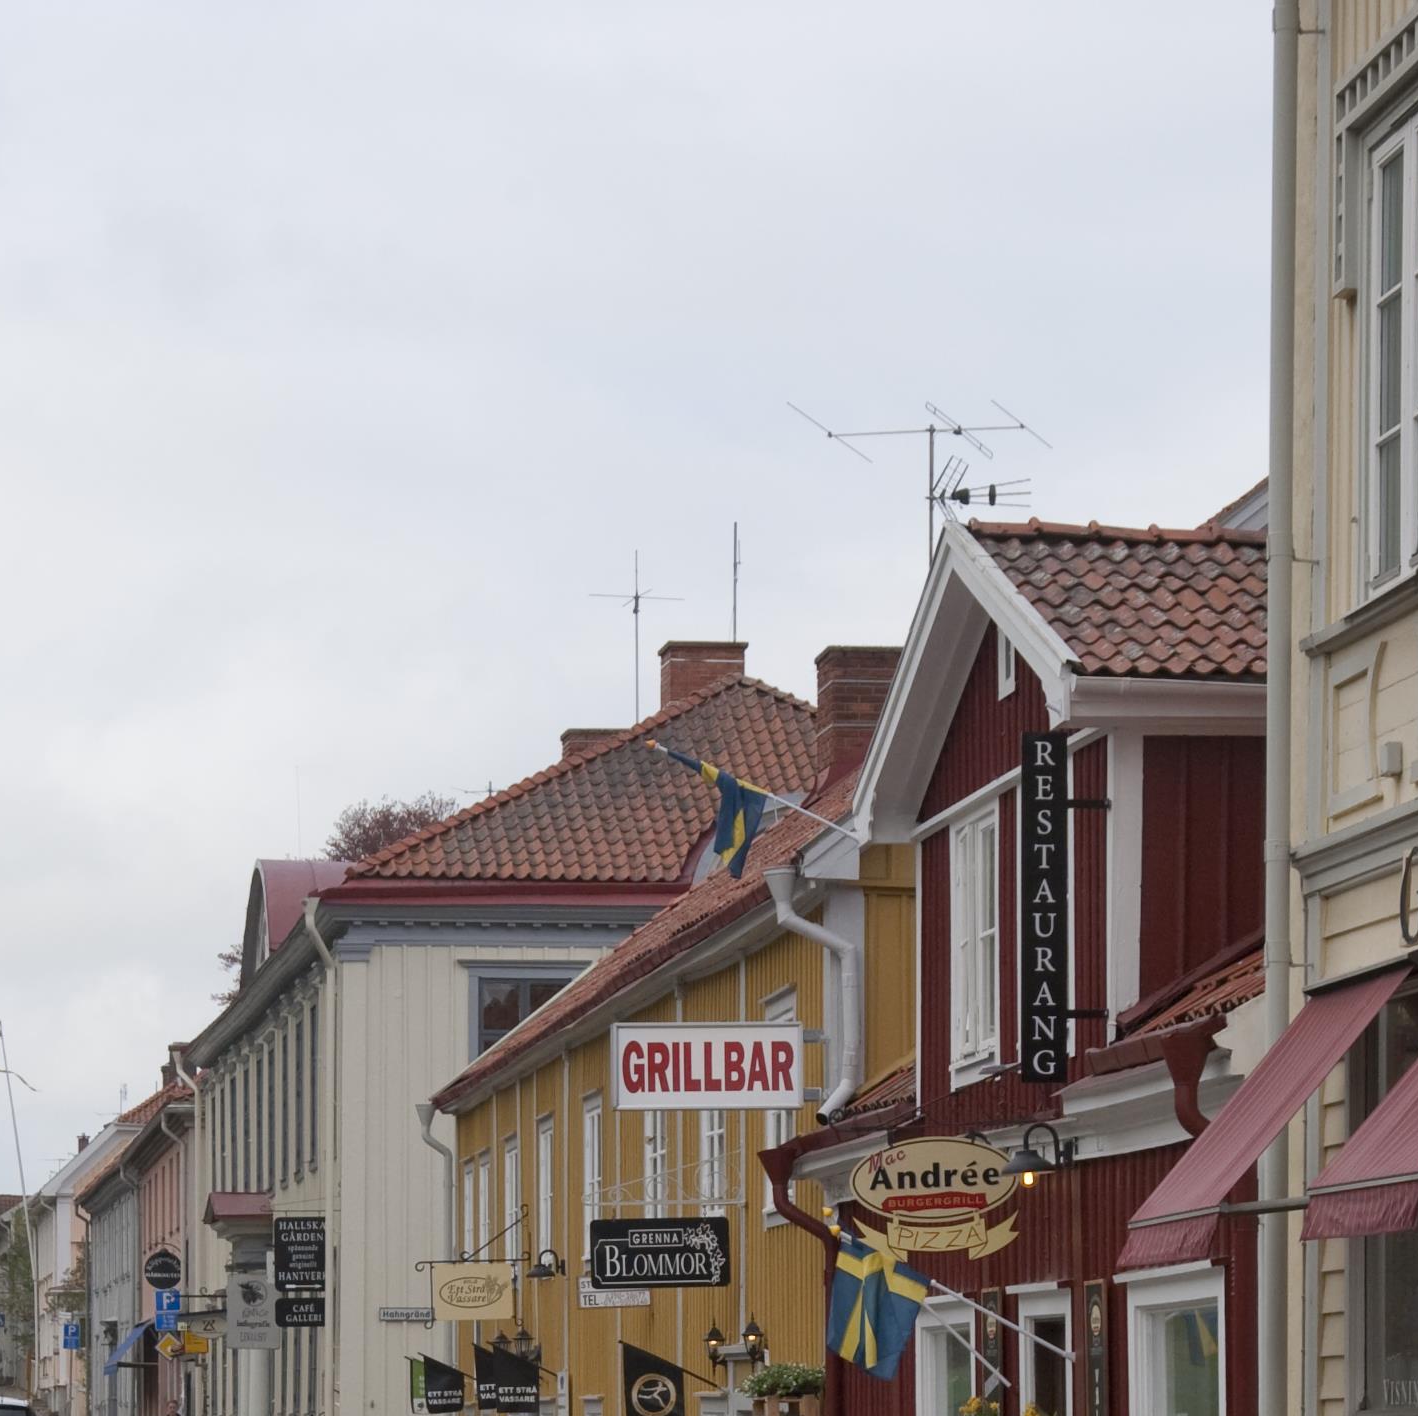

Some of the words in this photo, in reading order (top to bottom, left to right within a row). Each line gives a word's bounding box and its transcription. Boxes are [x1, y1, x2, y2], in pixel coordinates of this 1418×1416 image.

[1033, 739, 1057, 1077] RESTAURANG
[622, 1040, 794, 1093] GRILLBAR
[867, 1150, 907, 1174] Mac
[870, 1161, 1001, 1190] Andrée
[888, 1196, 982, 1208] BURGERGRILL
[279, 1221, 325, 1231] HALLSKA
[281, 1231, 324, 1242] GÅRDEN
[632, 1232, 680, 1244] GRENNA
[894, 1226, 983, 1249] PIZZA
[604, 1245, 708, 1277] BLOMMOR
[292, 1303, 315, 1313] CAFÉ
[285, 1313, 323, 1322] GALLERI
[382, 1310, 431, 1320] Hahngränd
[480, 1383, 495, 1391] ETT
[499, 1386, 515, 1394] ETT
